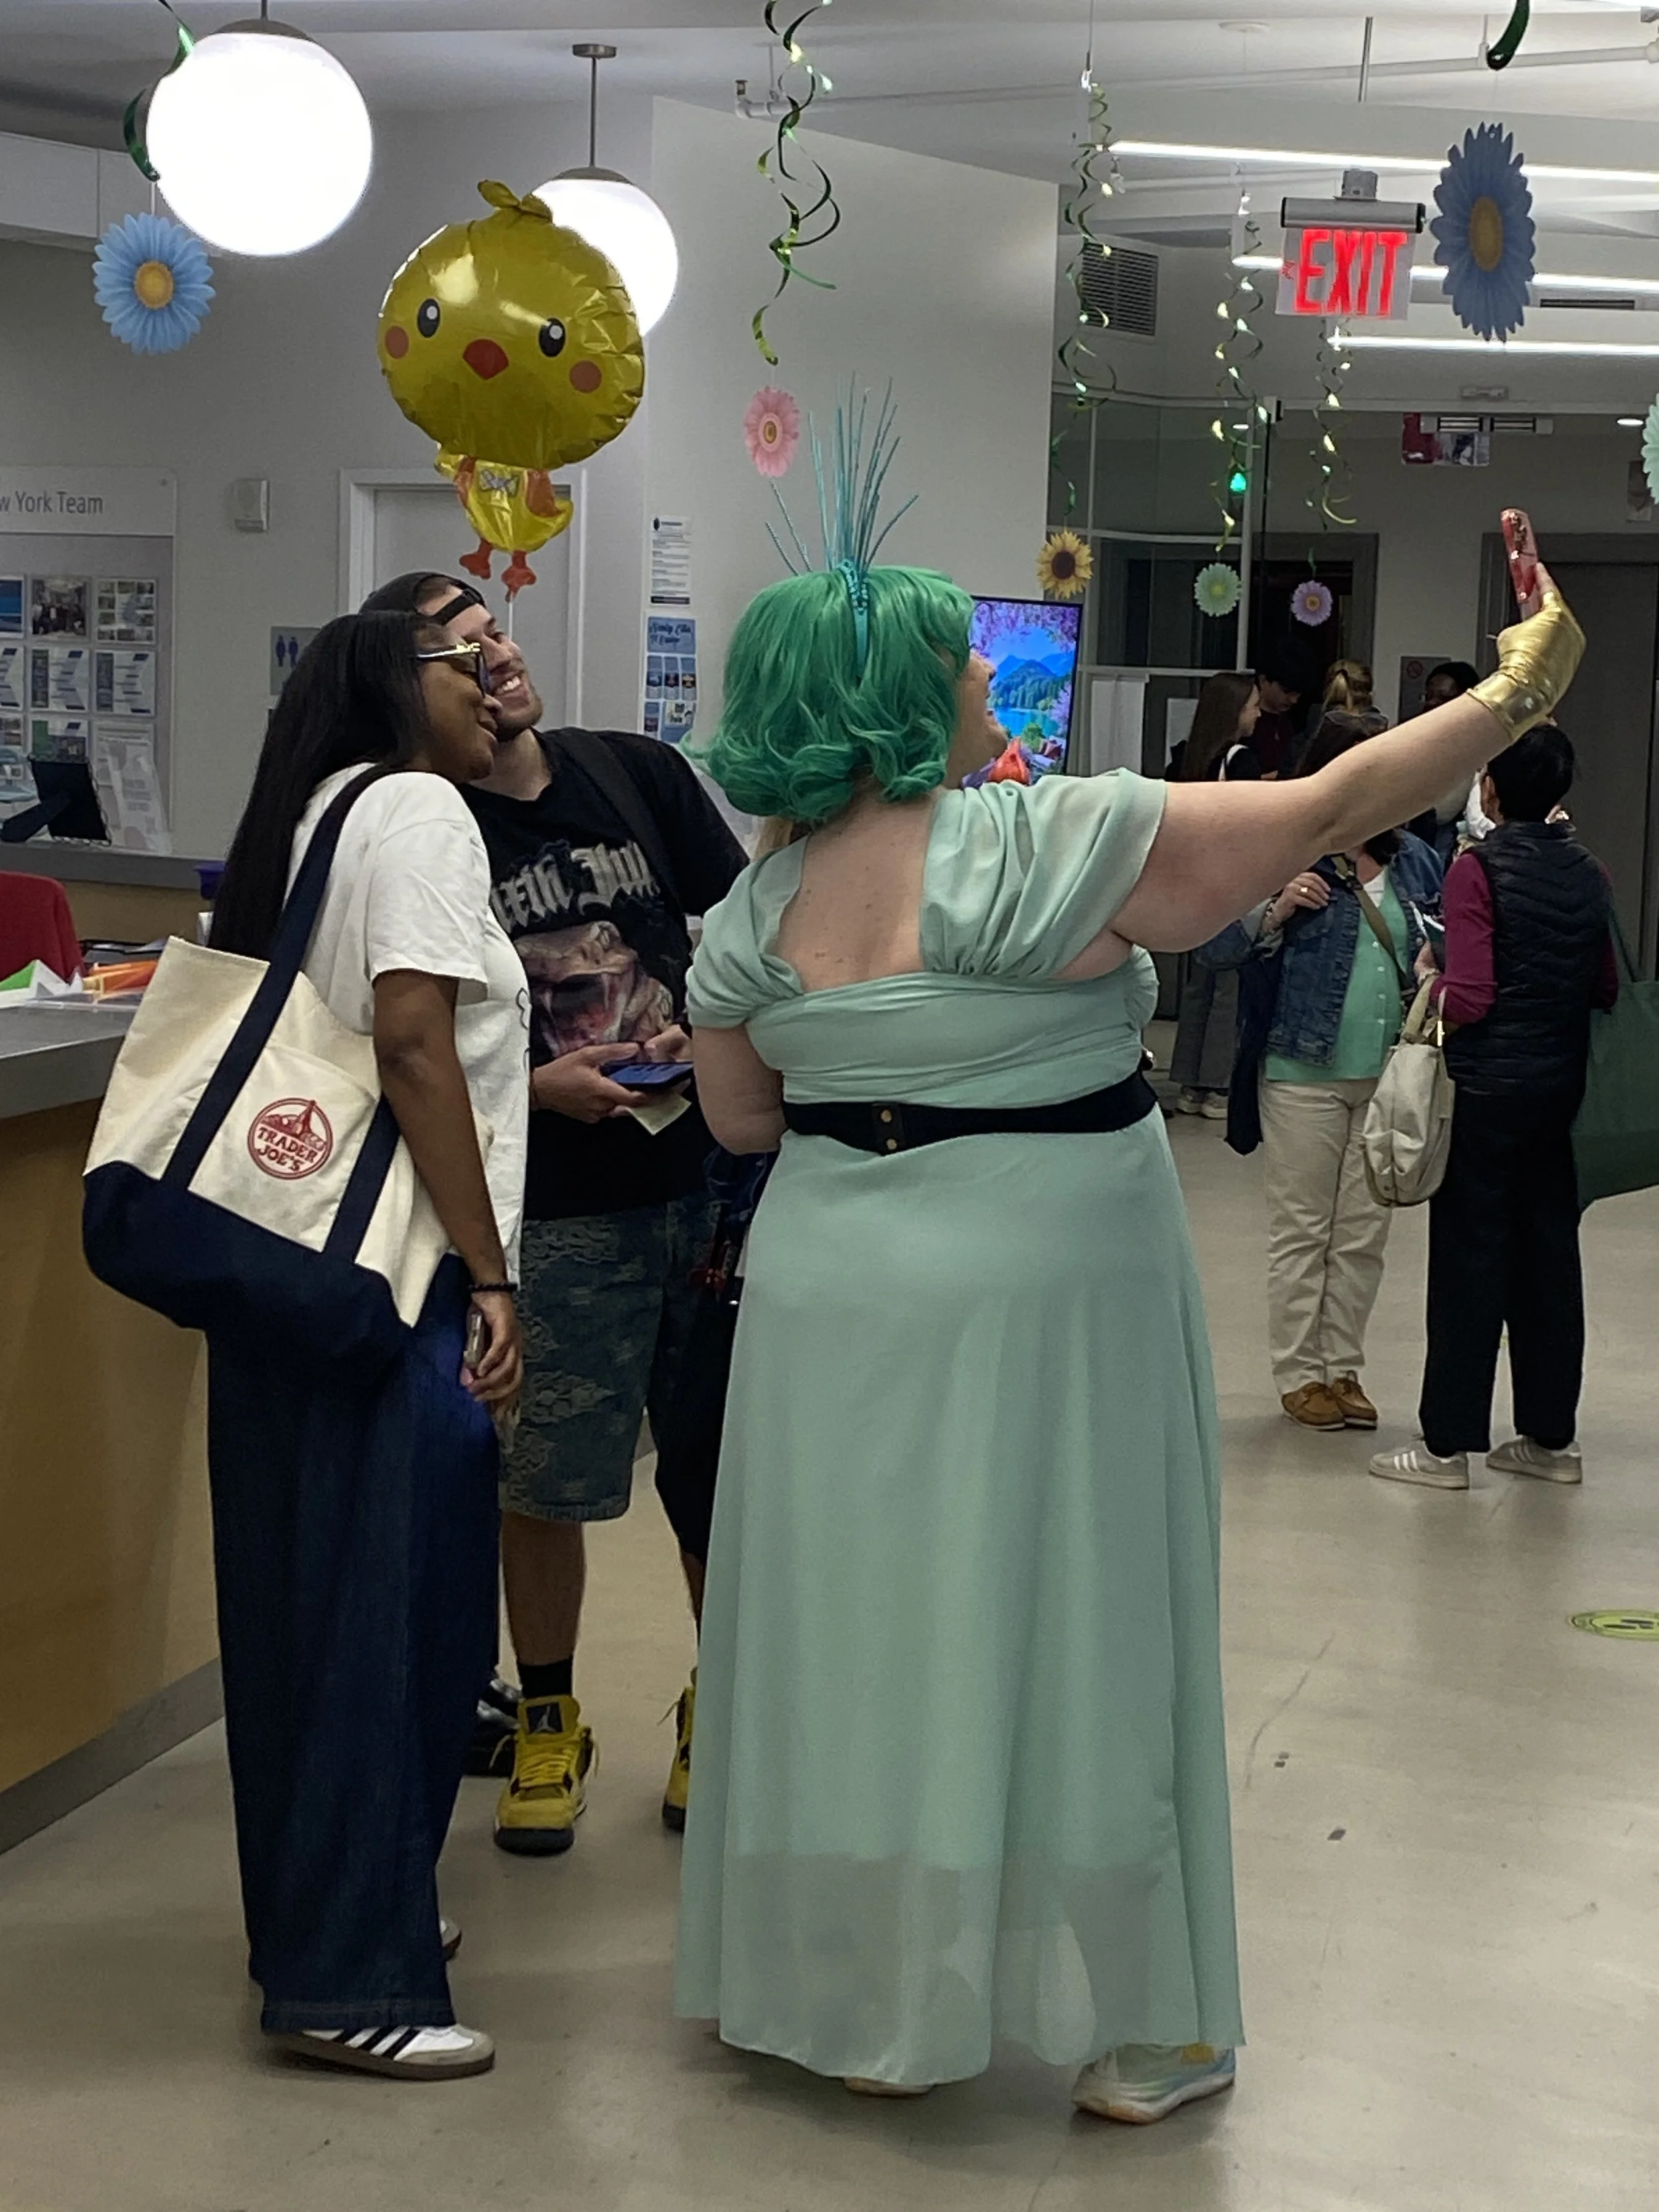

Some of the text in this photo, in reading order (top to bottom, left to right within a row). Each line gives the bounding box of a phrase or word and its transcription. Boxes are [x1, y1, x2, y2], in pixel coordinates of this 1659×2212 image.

[1294, 228, 1407, 316] EXIT
[15, 490, 52, 512] York
[56, 491, 104, 514] Team
[257, 1126, 318, 1163] TRADER
[257, 1145, 305, 1171] JOE'S
